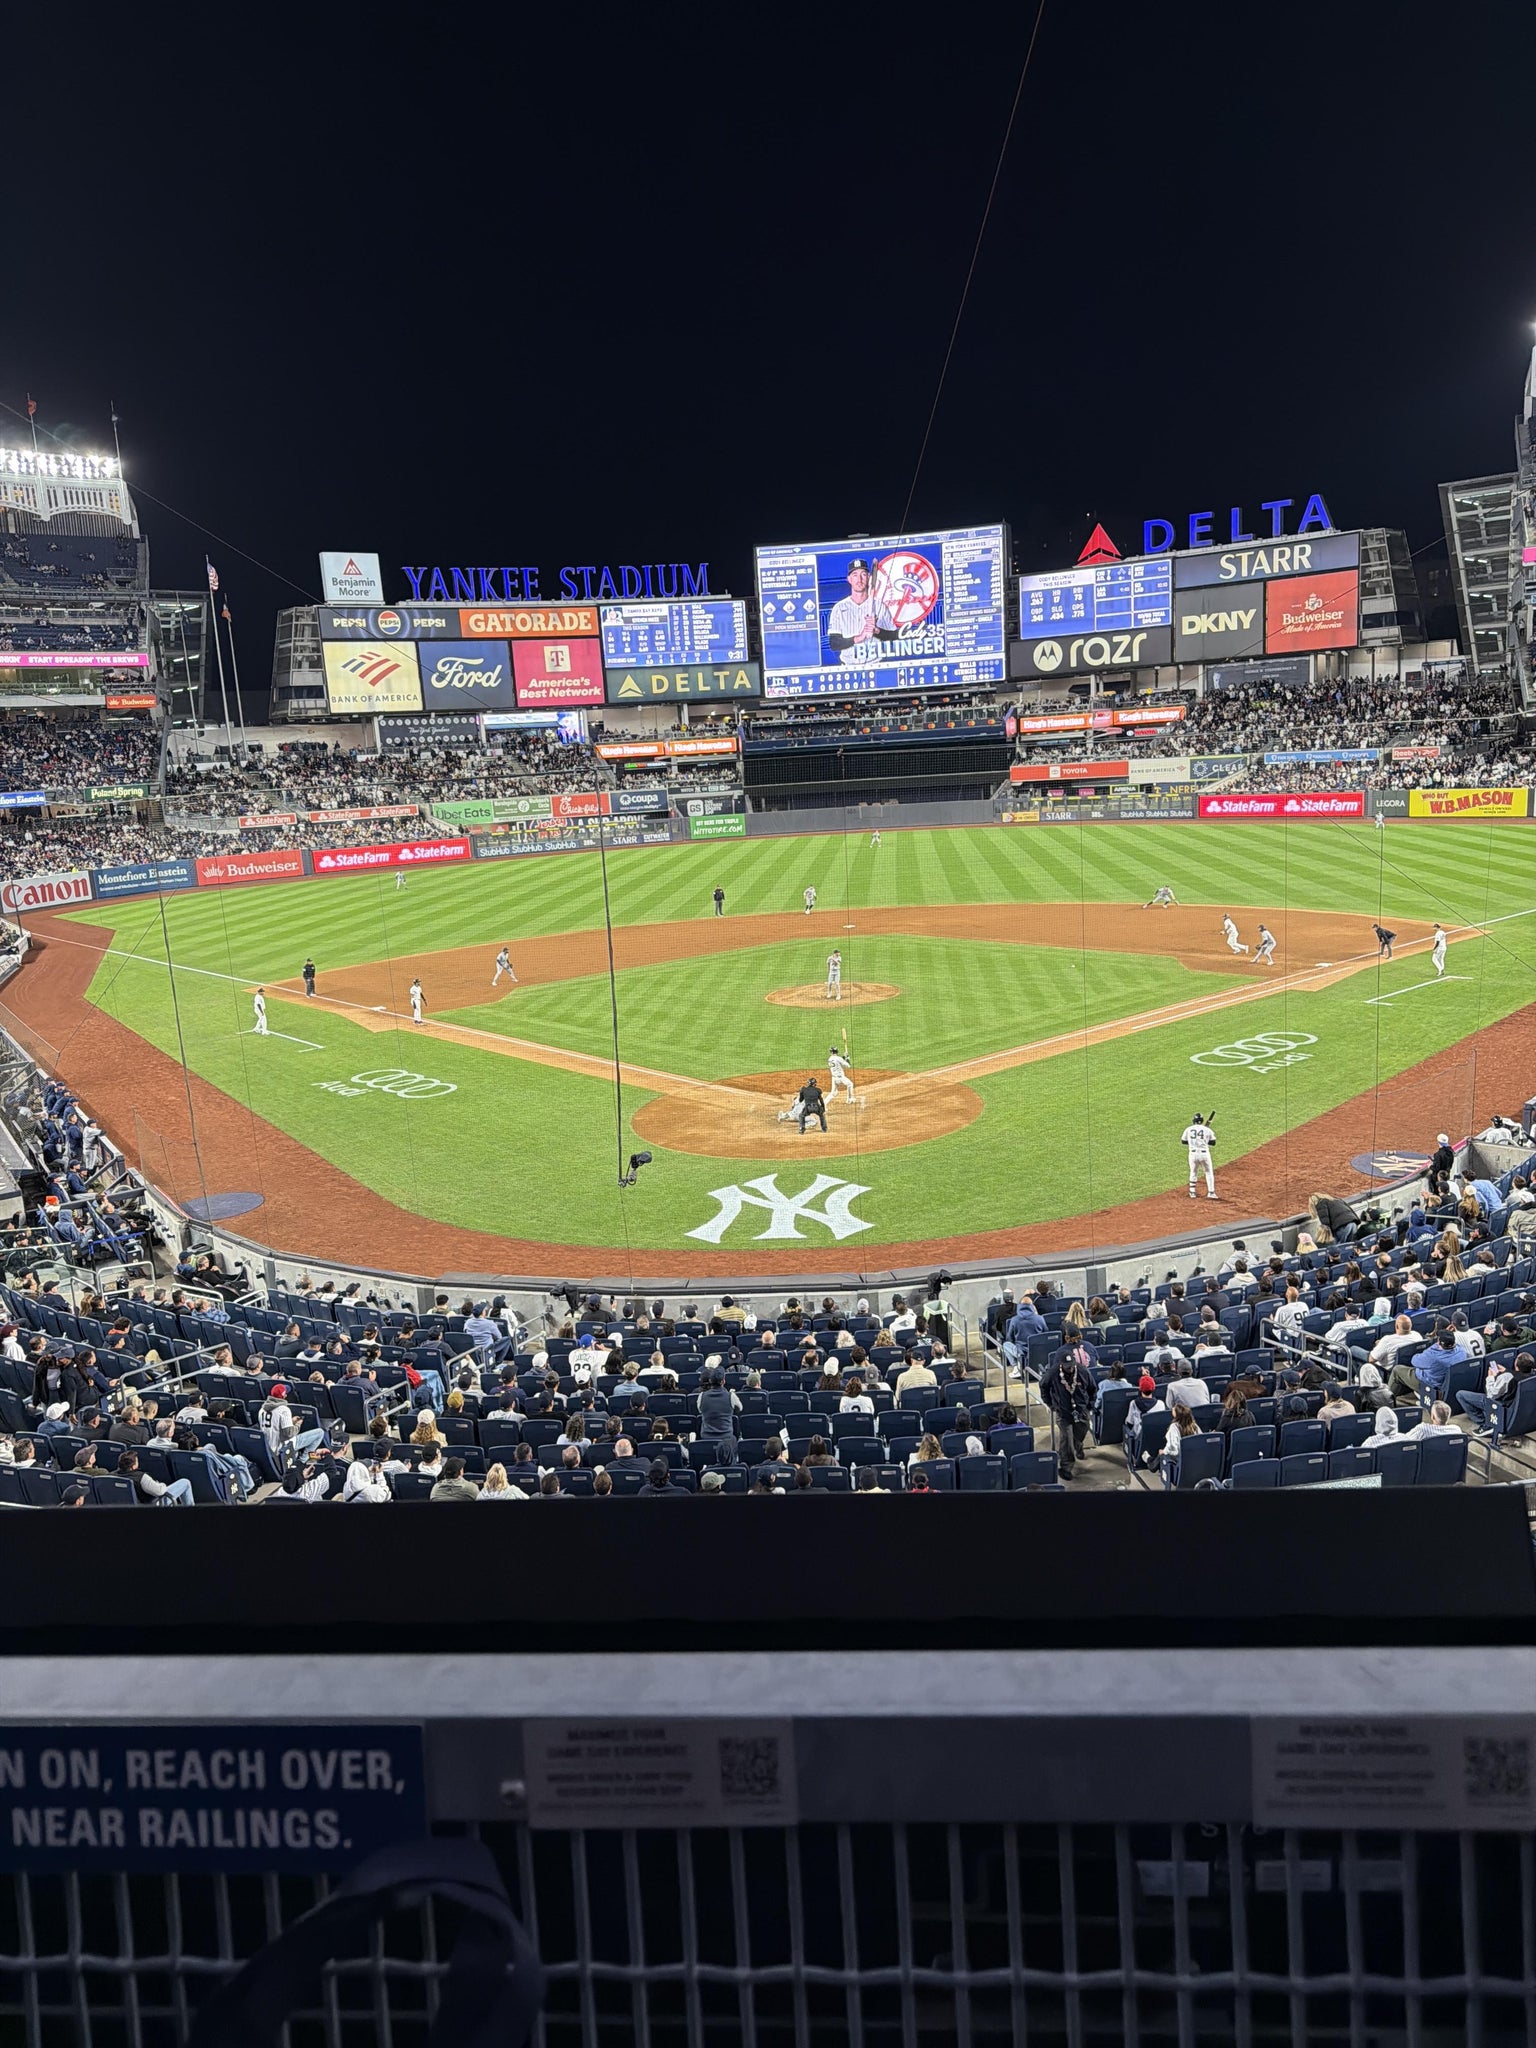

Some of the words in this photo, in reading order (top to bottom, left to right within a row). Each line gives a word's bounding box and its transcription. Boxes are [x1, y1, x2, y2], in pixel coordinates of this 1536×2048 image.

[1143, 494, 1333, 555] DELTA
[1219, 543, 1312, 579] STARR
[332, 577, 376, 588] Benjamin
[401, 567, 541, 601] YANKEE
[560, 562, 711, 599] STADIUM
[339, 588, 370, 596] Moore
[1051, 605, 1062, 613] SLG
[333, 618, 366, 628] PEPSI
[380, 619, 400, 627] PEPSI
[413, 618, 446, 628] PEPSI
[468, 611, 593, 634] GATORADE
[1181, 609, 1257, 635] DKNY
[1281, 610, 1344, 626] Budweiser
[898, 622, 927, 639] Cody
[927, 624, 945, 638] 35
[728, 651, 744, 659] 9:31
[854, 637, 945, 659] BELLINGER
[1070, 632, 1148, 668] razr
[551, 650, 565, 667] T
[431, 657, 502, 688] Ford
[528, 675, 591, 687] America's
[652, 670, 752, 694] DELTA
[331, 695, 358, 703] BANK
[373, 693, 419, 702] AMERICA
[519, 688, 553, 699] Best
[555, 686, 602, 697] Network
[121, 698, 156, 706] Budweiser
[1023, 718, 1046, 729] King's
[1047, 716, 1085, 727] Hawaiian
[1212, 763, 1244, 773] CLEAR
[91, 788, 117, 799] Poland
[118, 786, 144, 798] Spring
[632, 793, 659, 804] coupa
[690, 804, 701, 812] GS
[1376, 799, 1405, 807] LEGORA
[436, 809, 463, 820] Uber
[465, 807, 491, 819] Eats
[1046, 812, 1072, 820] STARR
[1120, 810, 1144, 818] StubHub
[578, 819, 585, 833] A
[613, 836, 637, 845] STARR
[644, 832, 669, 840] CUTWATER
[480, 847, 510, 857] StubHub
[512, 844, 543, 854] StubHub
[545, 841, 577, 851] StubHub
[98, 870, 147, 885] Montefiore
[148, 866, 187, 879] Einstein
[227, 862, 298, 877] Budweiser
[2, 877, 90, 909] Canon
[1249, 1053, 1314, 1074] Audi
[312, 1080, 373, 1098] Audi
[1190, 1129, 1204, 1139] 34
[684, 1173, 876, 1243] NY
[1470, 1340, 1482, 1356] 2
[261, 1411, 272, 1428] 19
[39, 1750, 113, 1793] ON,
[125, 1750, 266, 1790] REACH
[281, 1750, 406, 1795] OVER,
[12, 1808, 126, 1847] NEAR
[139, 1808, 352, 1849] RAILINGS.
